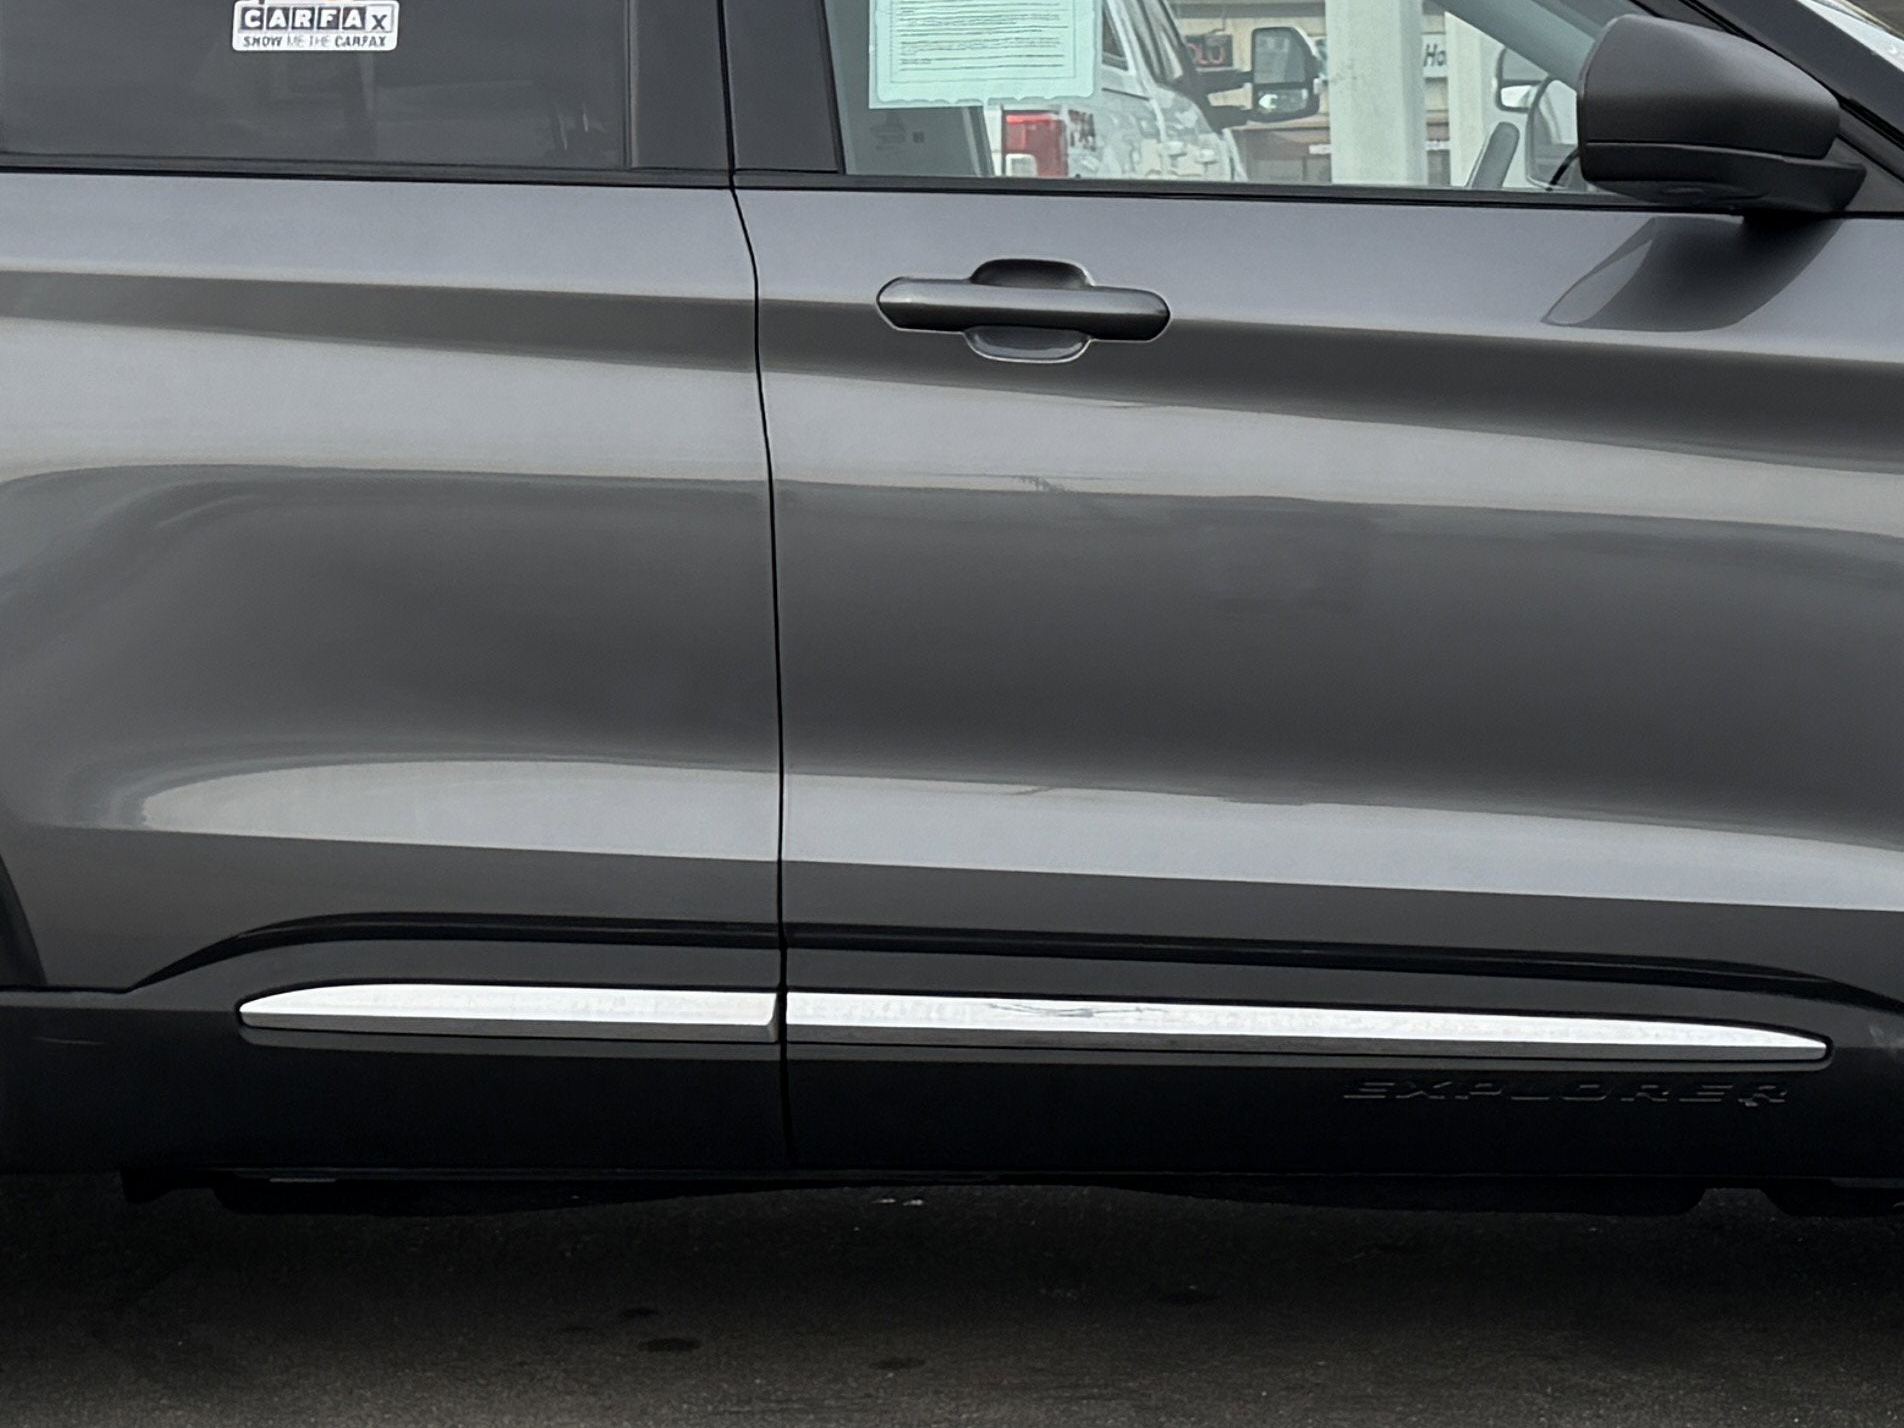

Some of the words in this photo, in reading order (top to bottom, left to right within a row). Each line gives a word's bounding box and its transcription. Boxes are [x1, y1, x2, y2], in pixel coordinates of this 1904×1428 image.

[242, 7, 388, 32] CARFAX
[243, 35, 282, 48] SHOW
[334, 35, 387, 48] CARFAX
[1343, 1081, 1788, 1106] EXPLORER
